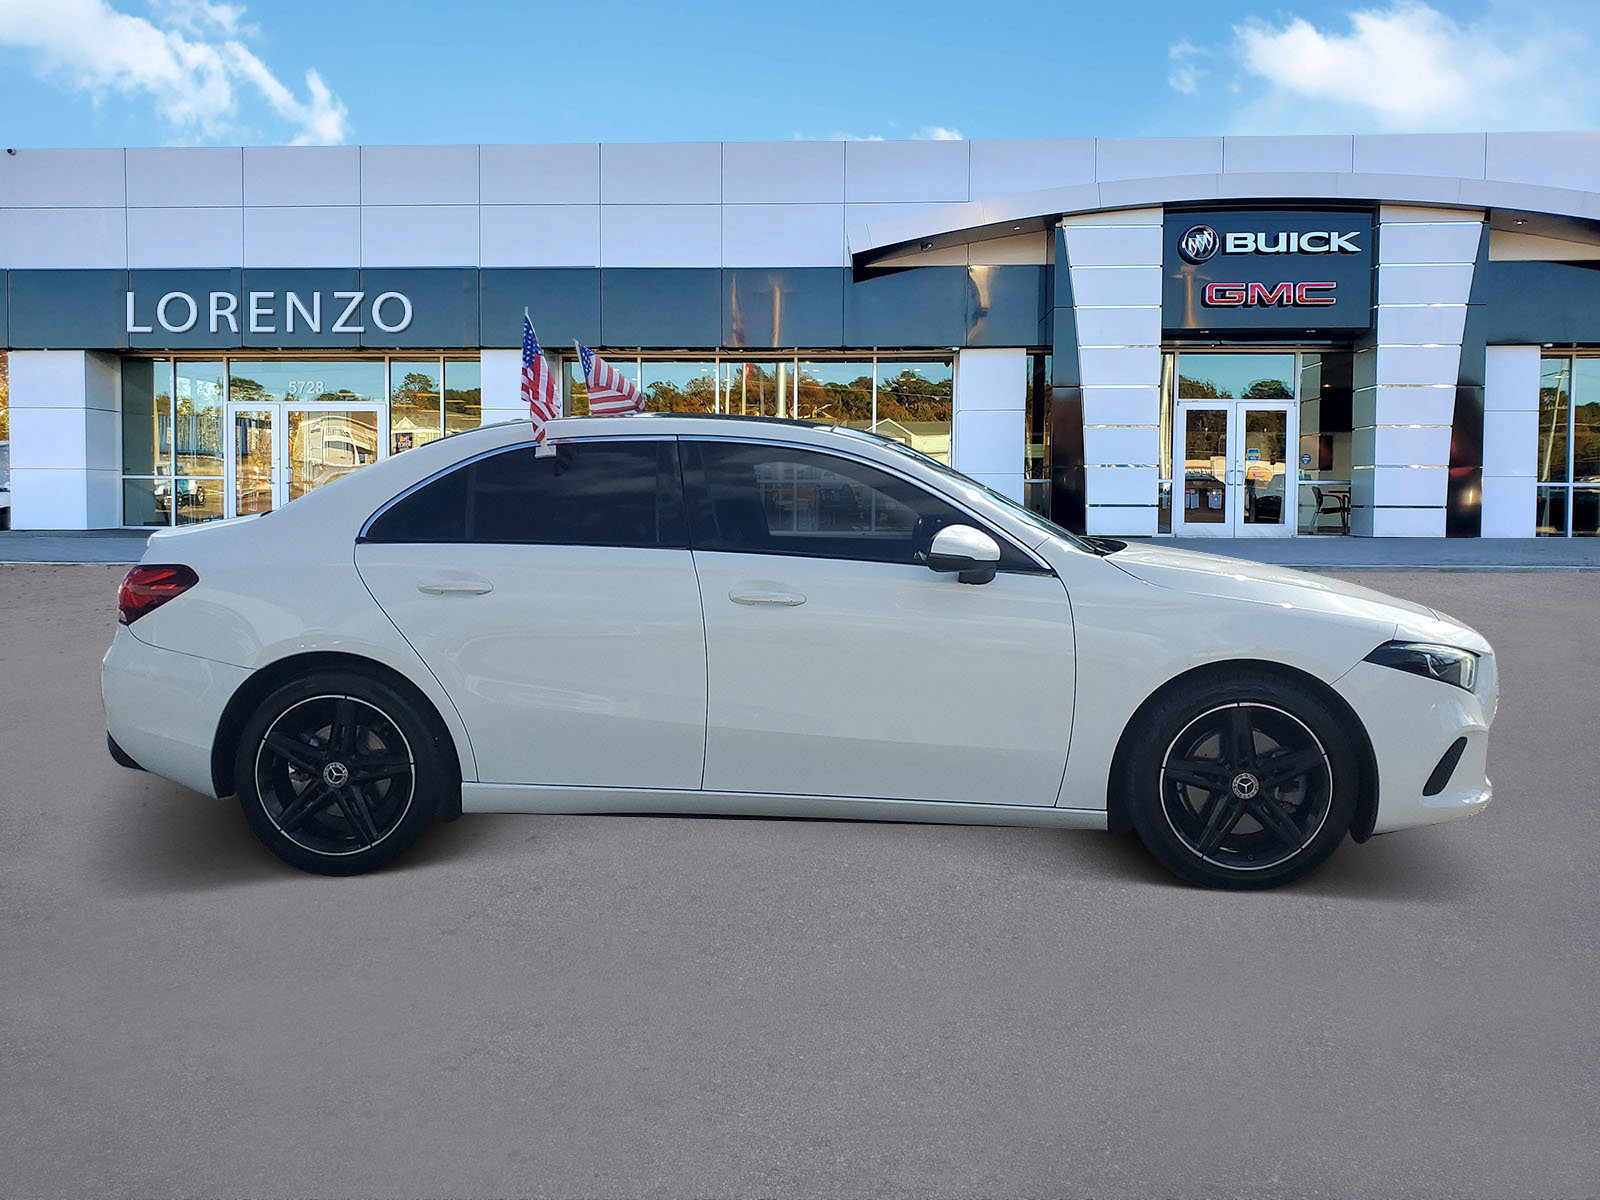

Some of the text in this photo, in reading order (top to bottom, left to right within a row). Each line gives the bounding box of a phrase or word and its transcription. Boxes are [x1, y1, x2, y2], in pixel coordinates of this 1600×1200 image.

[1225, 231, 1362, 253] BUICK
[1205, 281, 1337, 306] GMC
[126, 291, 414, 334] LORENZO
[288, 380, 325, 394] 5728
